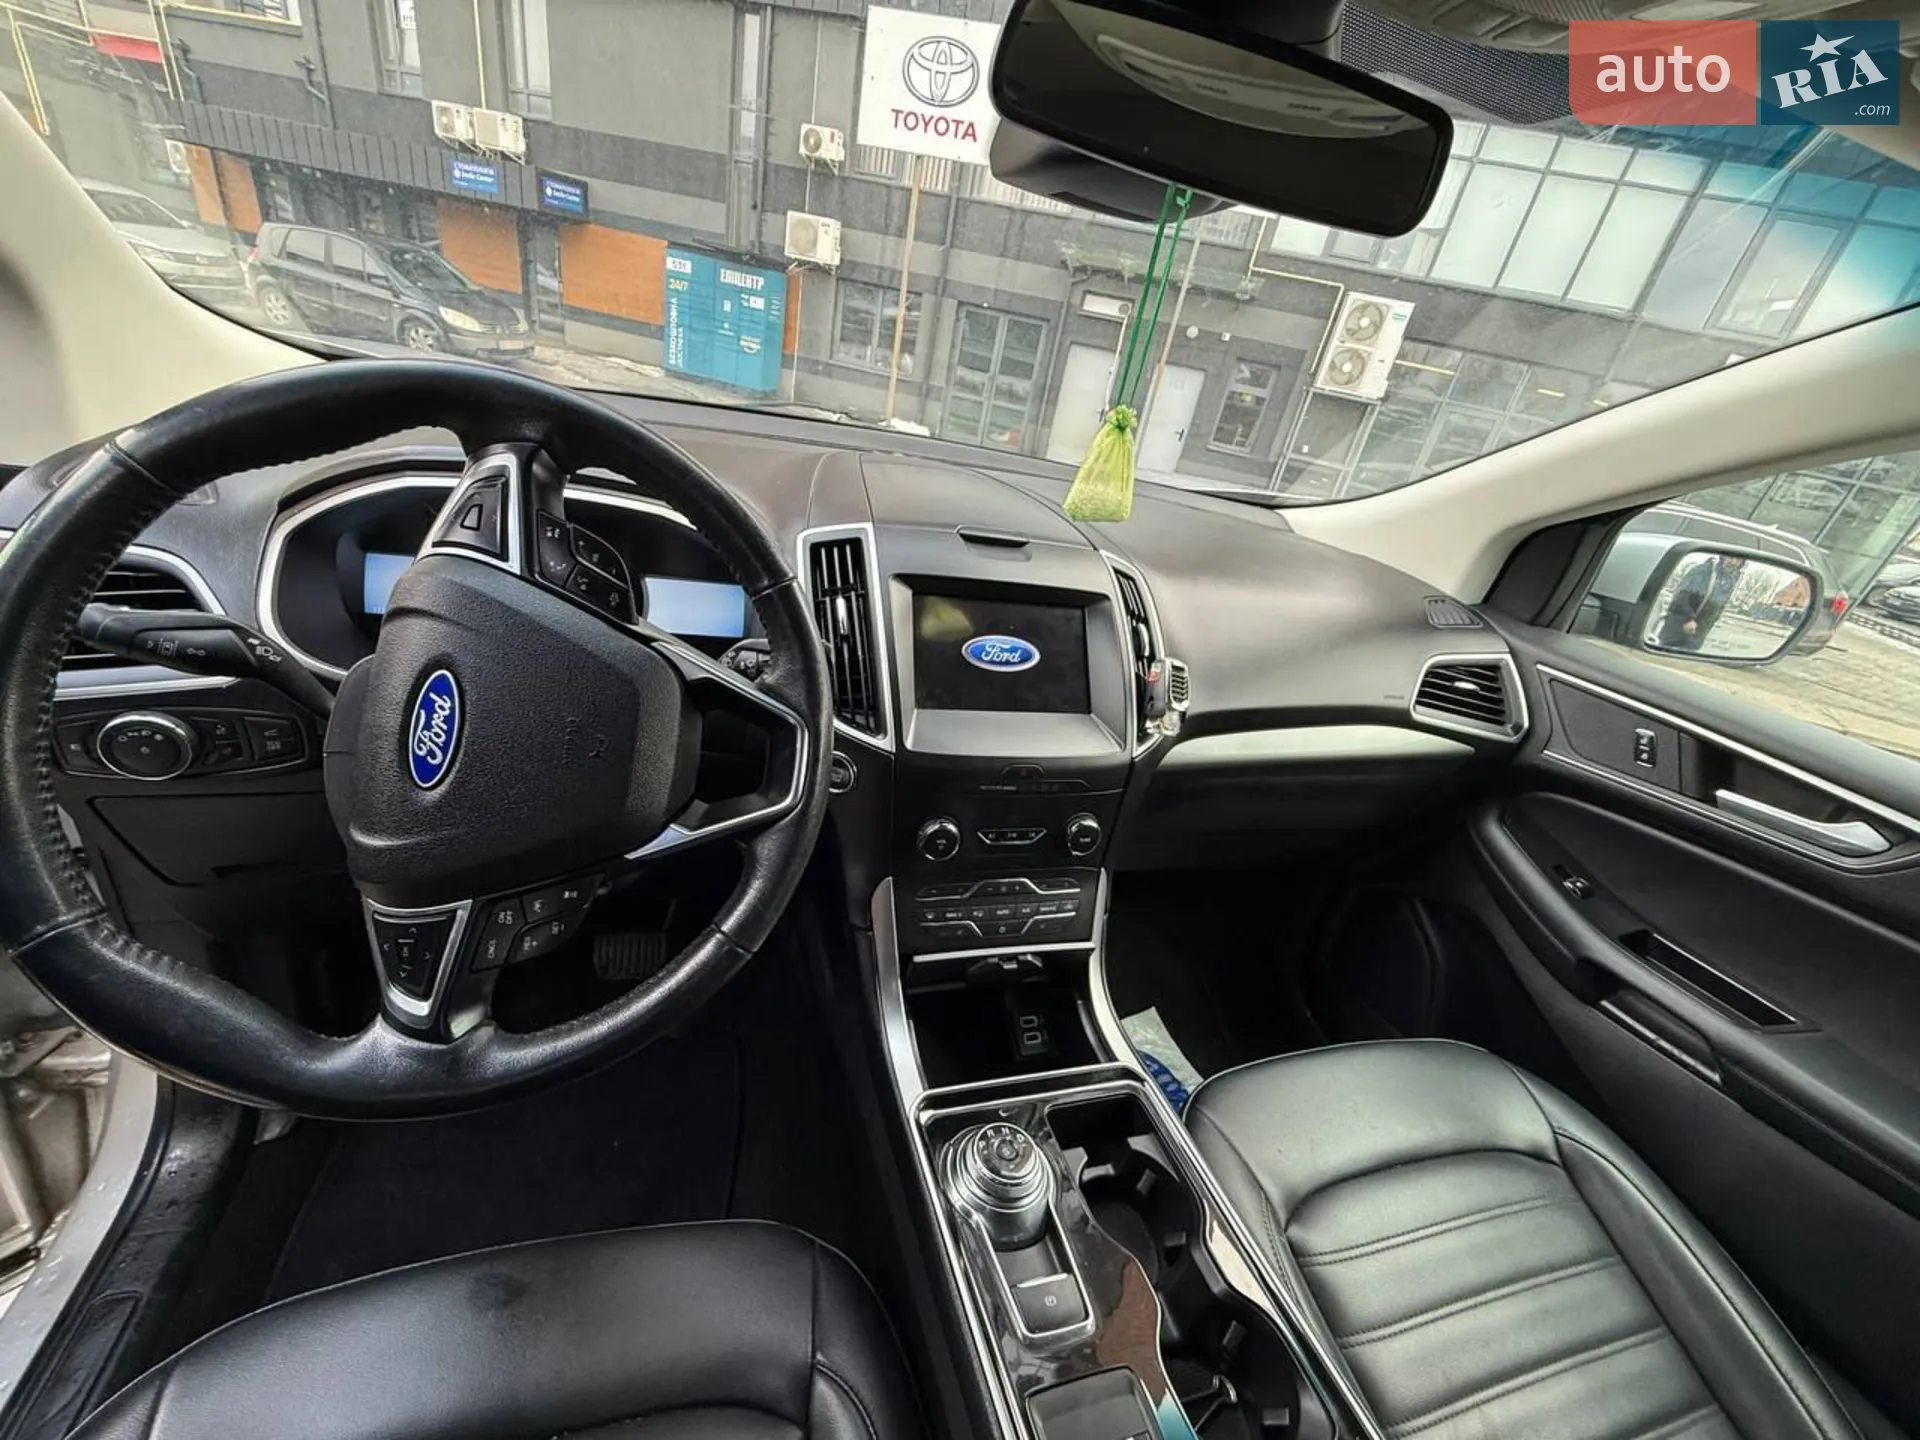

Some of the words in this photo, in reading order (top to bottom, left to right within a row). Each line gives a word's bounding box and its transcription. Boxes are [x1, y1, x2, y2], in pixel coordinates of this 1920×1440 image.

[891, 108, 978, 142] TOYOTA
[669, 279, 688, 291] 24/7
[981, 642, 1022, 663] Ford
[413, 691, 452, 766] Ford
